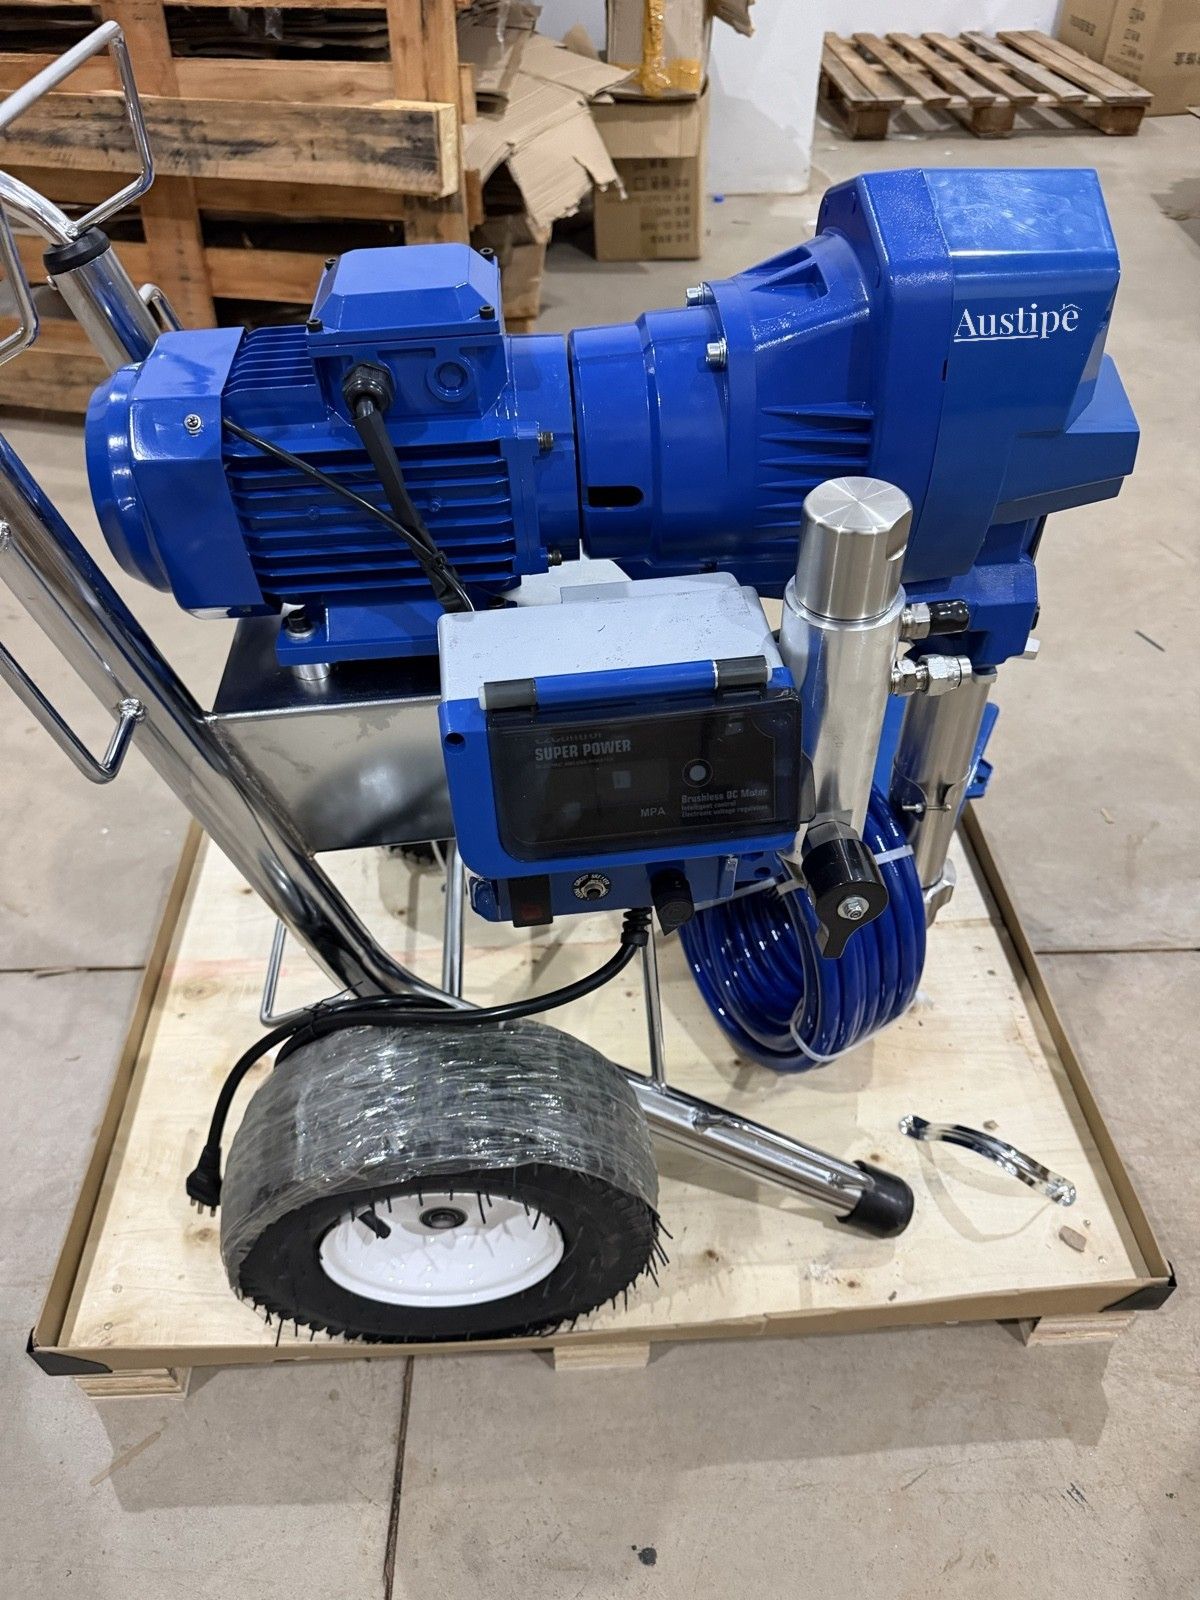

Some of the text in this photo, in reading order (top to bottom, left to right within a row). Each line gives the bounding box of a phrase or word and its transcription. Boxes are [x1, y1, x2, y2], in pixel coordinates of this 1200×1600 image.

[534, 739, 631, 762] SUPER POWER
[681, 789, 768, 804] Brushless DC Motor
[640, 806, 666, 817] MPA
